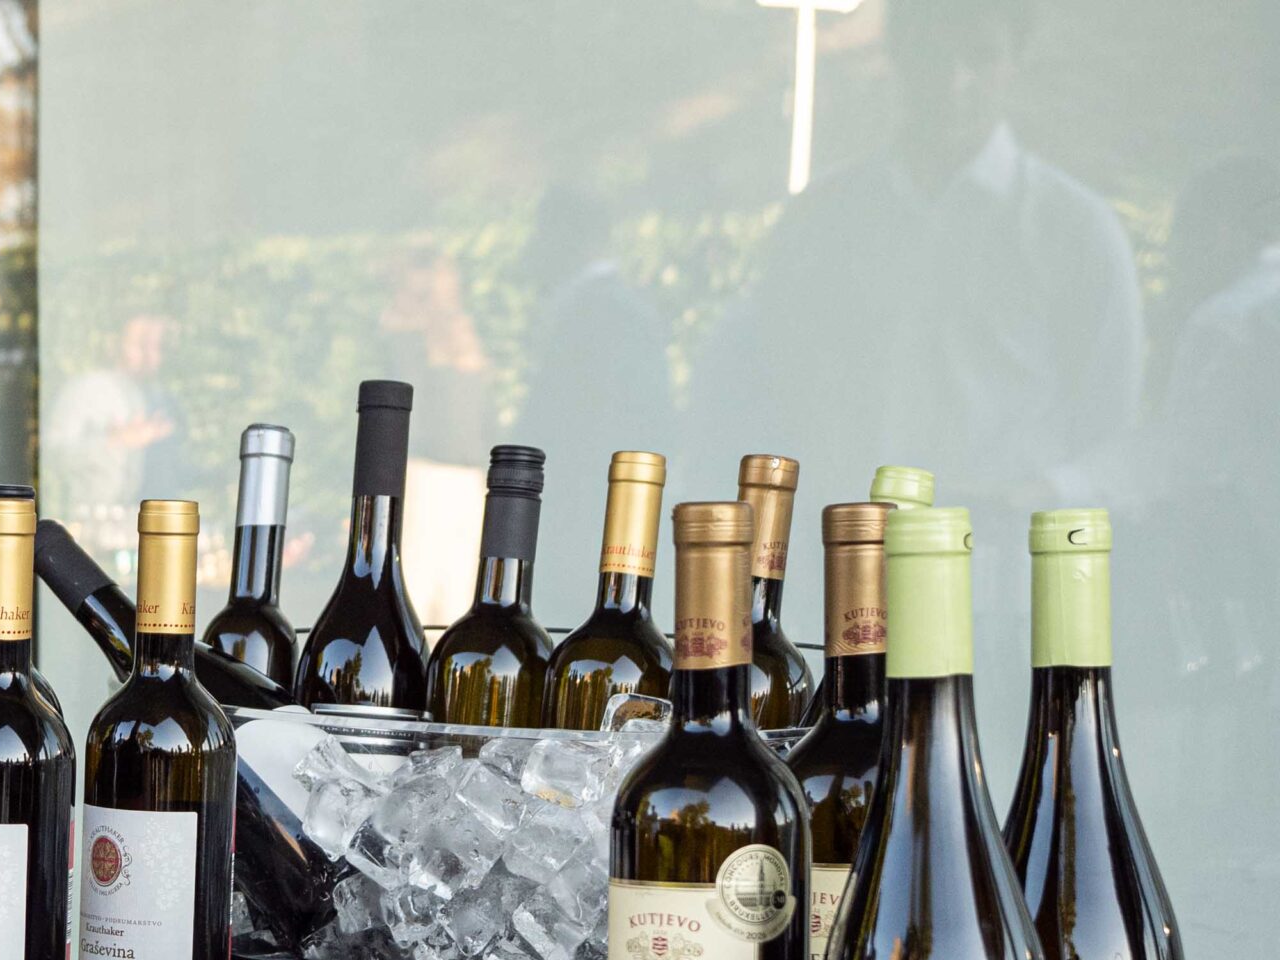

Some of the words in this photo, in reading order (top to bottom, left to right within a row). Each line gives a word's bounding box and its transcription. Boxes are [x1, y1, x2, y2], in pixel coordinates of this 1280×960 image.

[85, 922, 124, 937] Krauthaker
[628, 912, 701, 932] KUTJEVO
[80, 938, 135, 960] Graševina
